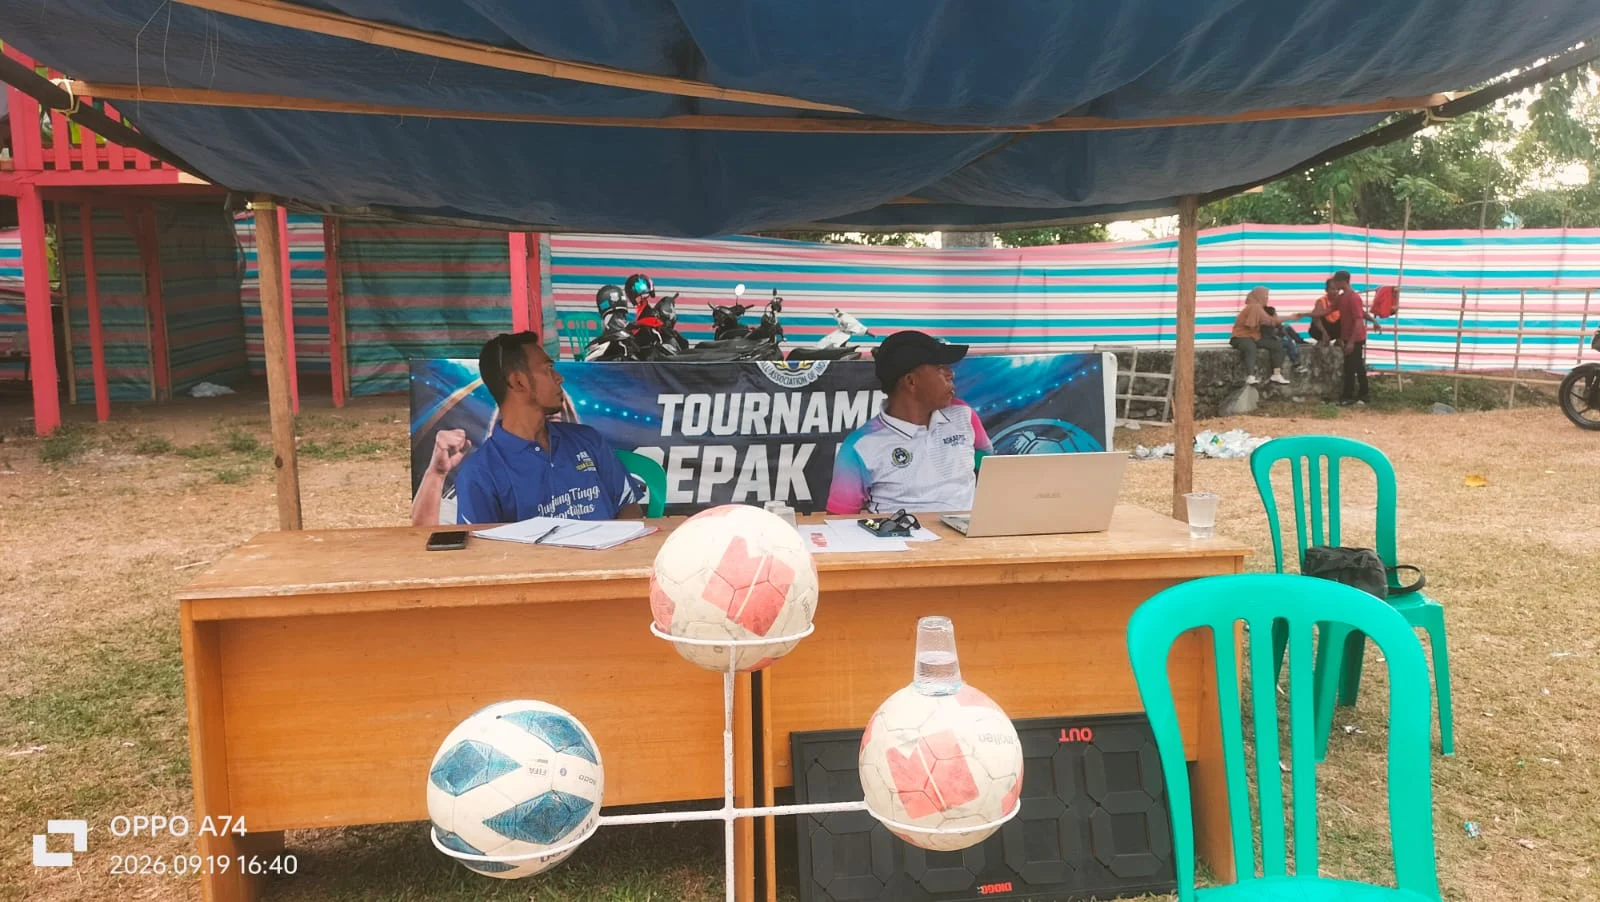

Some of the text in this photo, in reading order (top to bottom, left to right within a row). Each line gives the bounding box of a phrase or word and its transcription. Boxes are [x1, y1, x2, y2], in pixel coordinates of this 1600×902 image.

[769, 370, 808, 385] ASSOCIATION
[1059, 726, 1092, 743] OUT
[529, 767, 547, 777] FIFA
